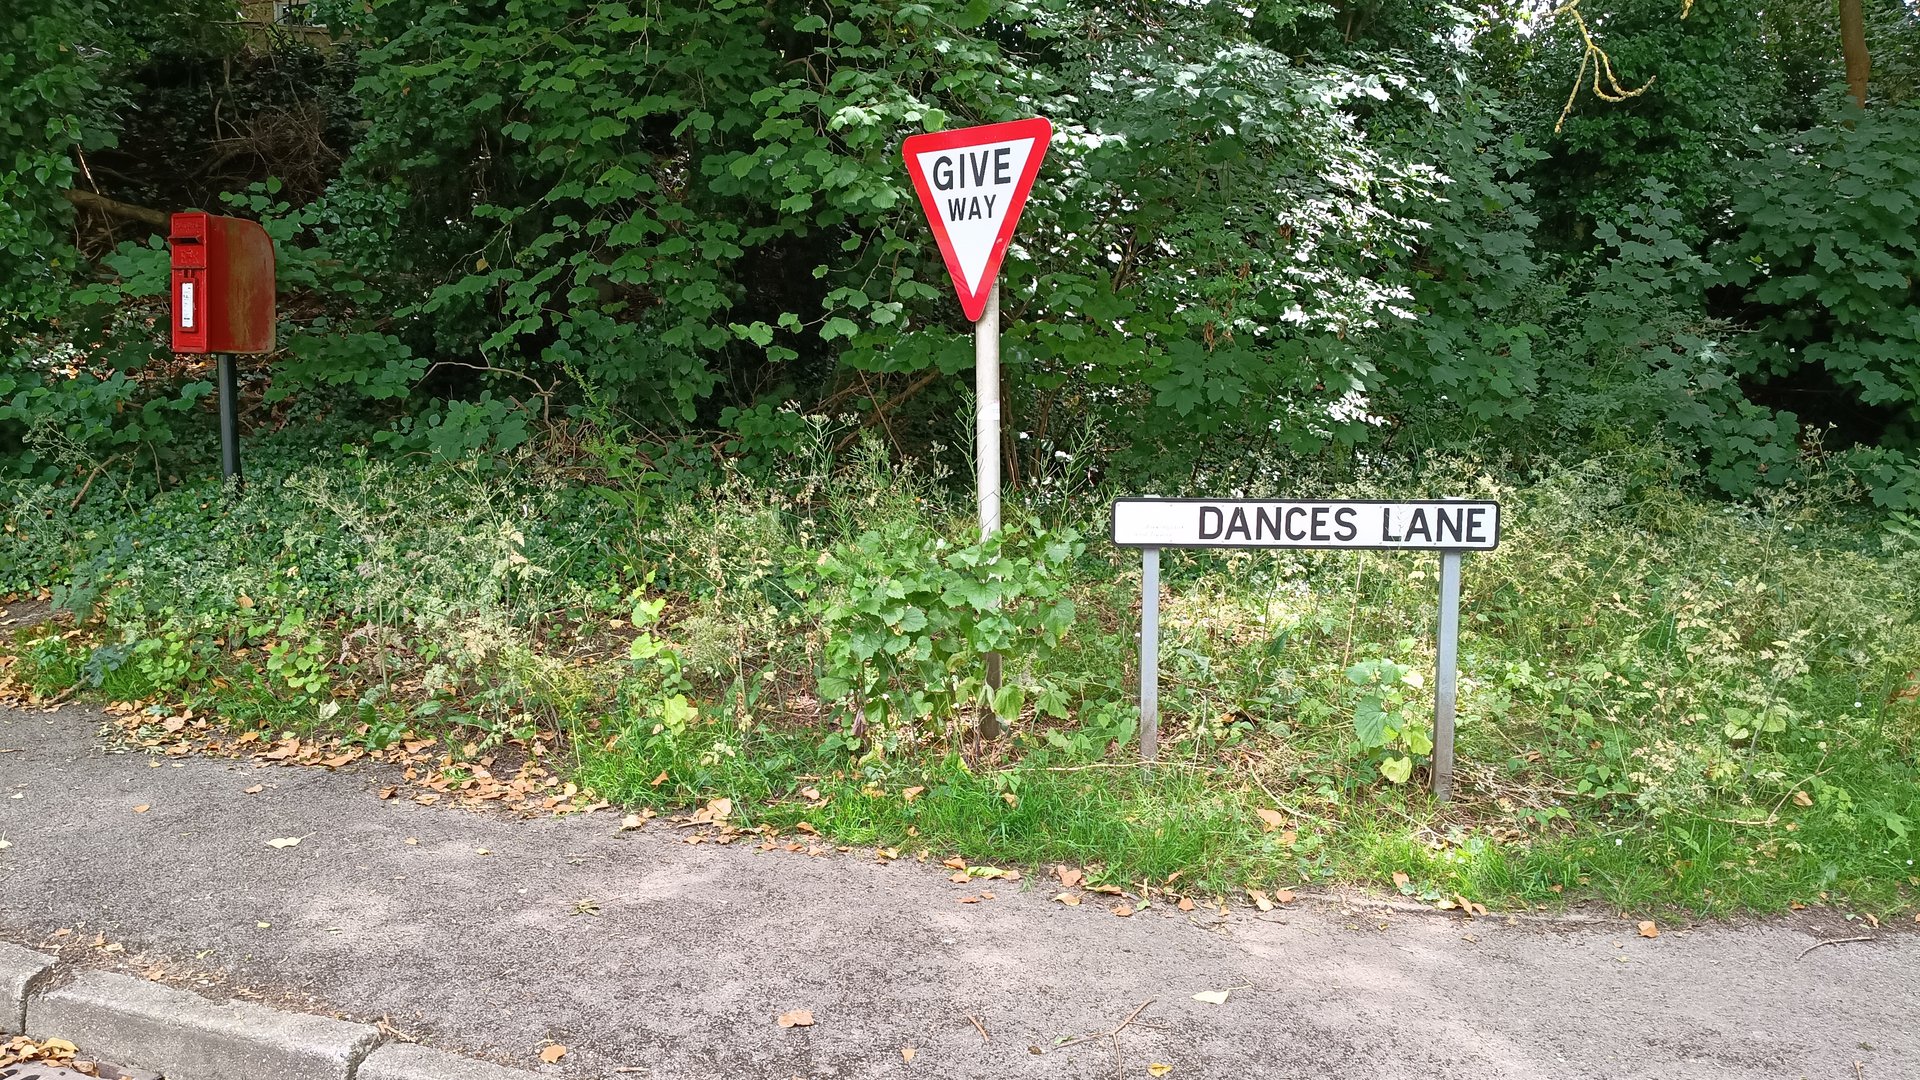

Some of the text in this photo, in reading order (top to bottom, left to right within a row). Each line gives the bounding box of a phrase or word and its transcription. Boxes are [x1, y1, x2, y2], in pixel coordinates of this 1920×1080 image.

[933, 148, 1011, 191] GIVE
[948, 194, 996, 221] WAY
[1198, 506, 1487, 542] DANCES LANE
